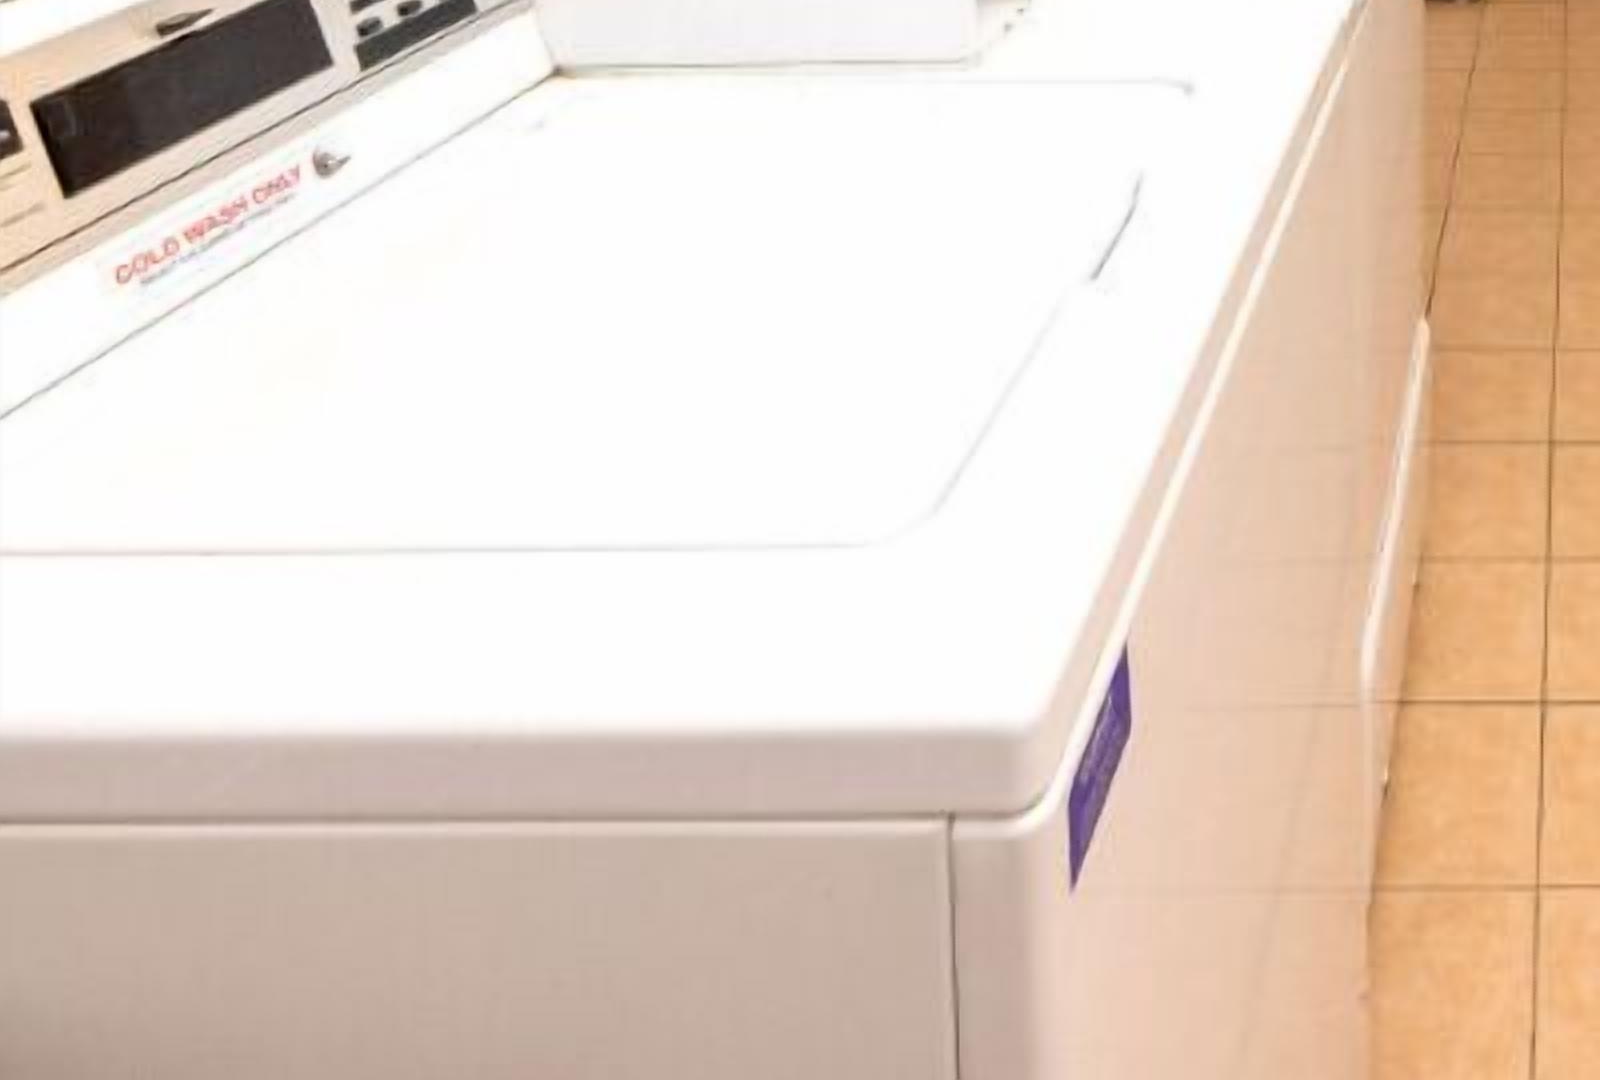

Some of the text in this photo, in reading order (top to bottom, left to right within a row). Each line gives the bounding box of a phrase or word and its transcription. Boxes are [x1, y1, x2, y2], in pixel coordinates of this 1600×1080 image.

[115, 236, 180, 284] COLD
[183, 196, 248, 243] WASH
[252, 165, 300, 204] ONLY
